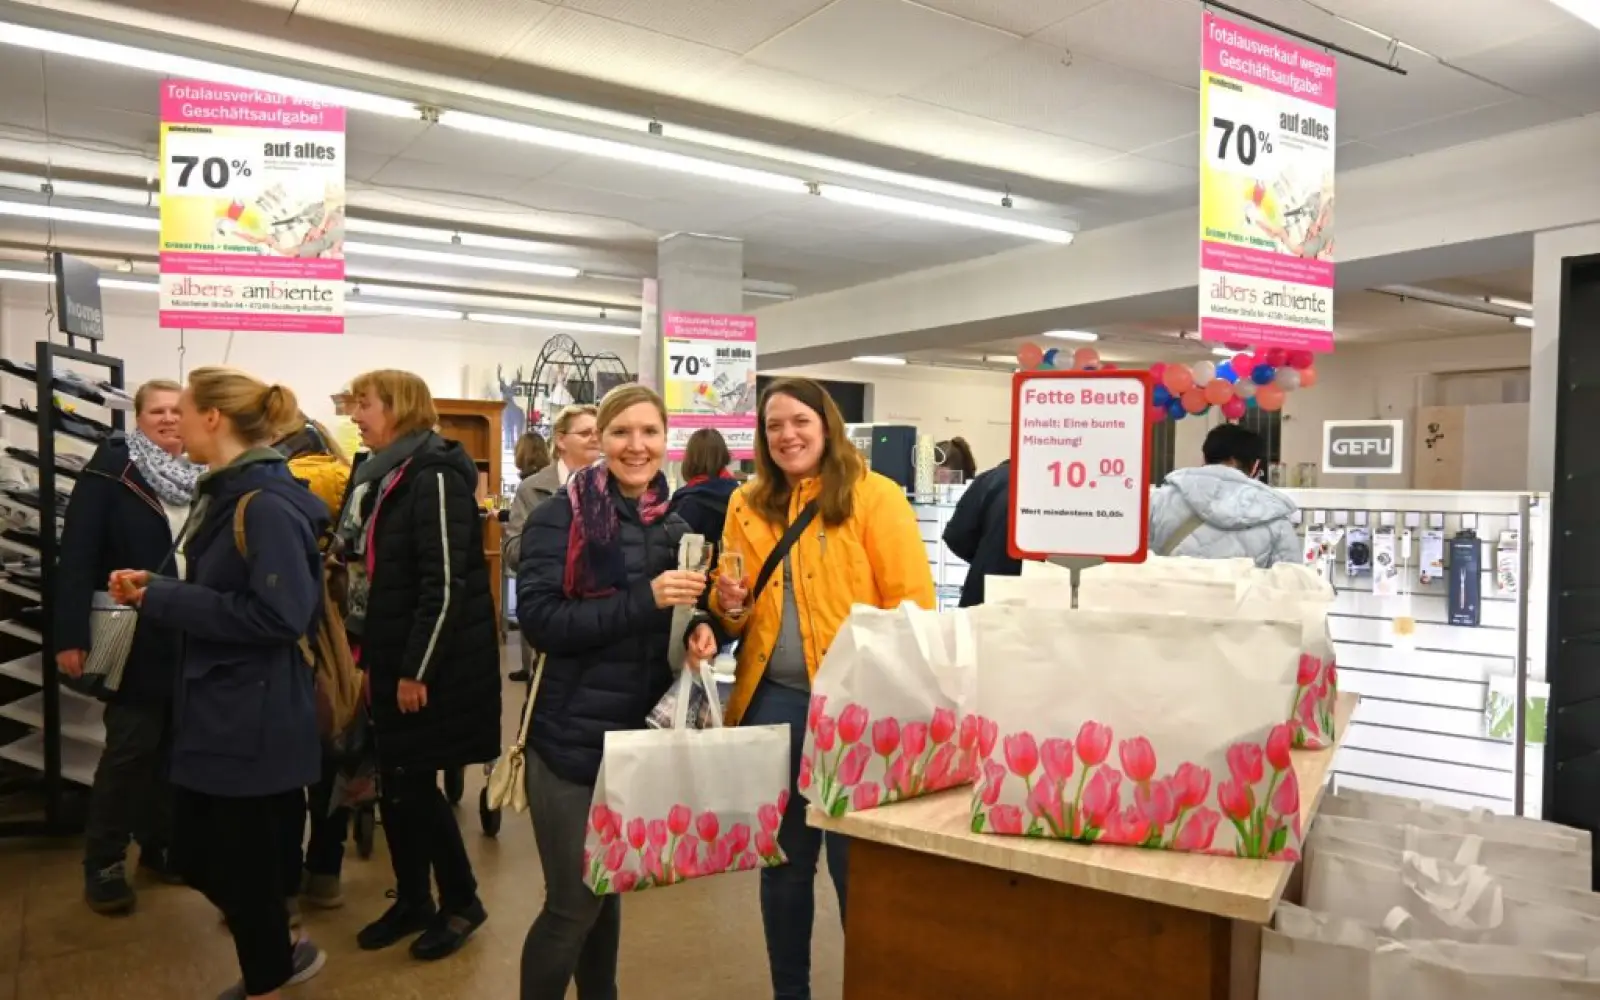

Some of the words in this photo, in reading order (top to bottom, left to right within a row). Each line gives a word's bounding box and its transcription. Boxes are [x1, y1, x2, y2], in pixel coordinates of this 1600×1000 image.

[1209, 22, 1298, 66] Totalausverkauf
[1300, 56, 1333, 80] wegen
[1220, 50, 1323, 96] Geschäftsaufgabe!
[168, 84, 286, 105] Totalausverkauf
[182, 103, 323, 125] Geschäftsaufgabe!
[1280, 112, 1299, 132] auf
[1301, 117, 1329, 141] alles
[264, 141, 290, 158] auf
[295, 143, 336, 160] alles
[1213, 117, 1272, 166] 70%
[171, 155, 252, 189] 70%
[171, 277, 234, 298] albers
[241, 281, 333, 302] ambiente
[1211, 276, 1257, 303] albers
[1263, 285, 1326, 313] ambiente
[66, 295, 101, 323] home
[1024, 389, 1075, 405] Fette
[1080, 389, 1139, 405] Beute
[1024, 418, 1060, 429] Inhalt:
[1063, 418, 1089, 429] Eine
[1091, 418, 1126, 429] bunte
[1024, 435, 1082, 448] Mischung!
[1332, 438, 1391, 455] GEFU
[1043, 508, 1093, 518] mindestens
